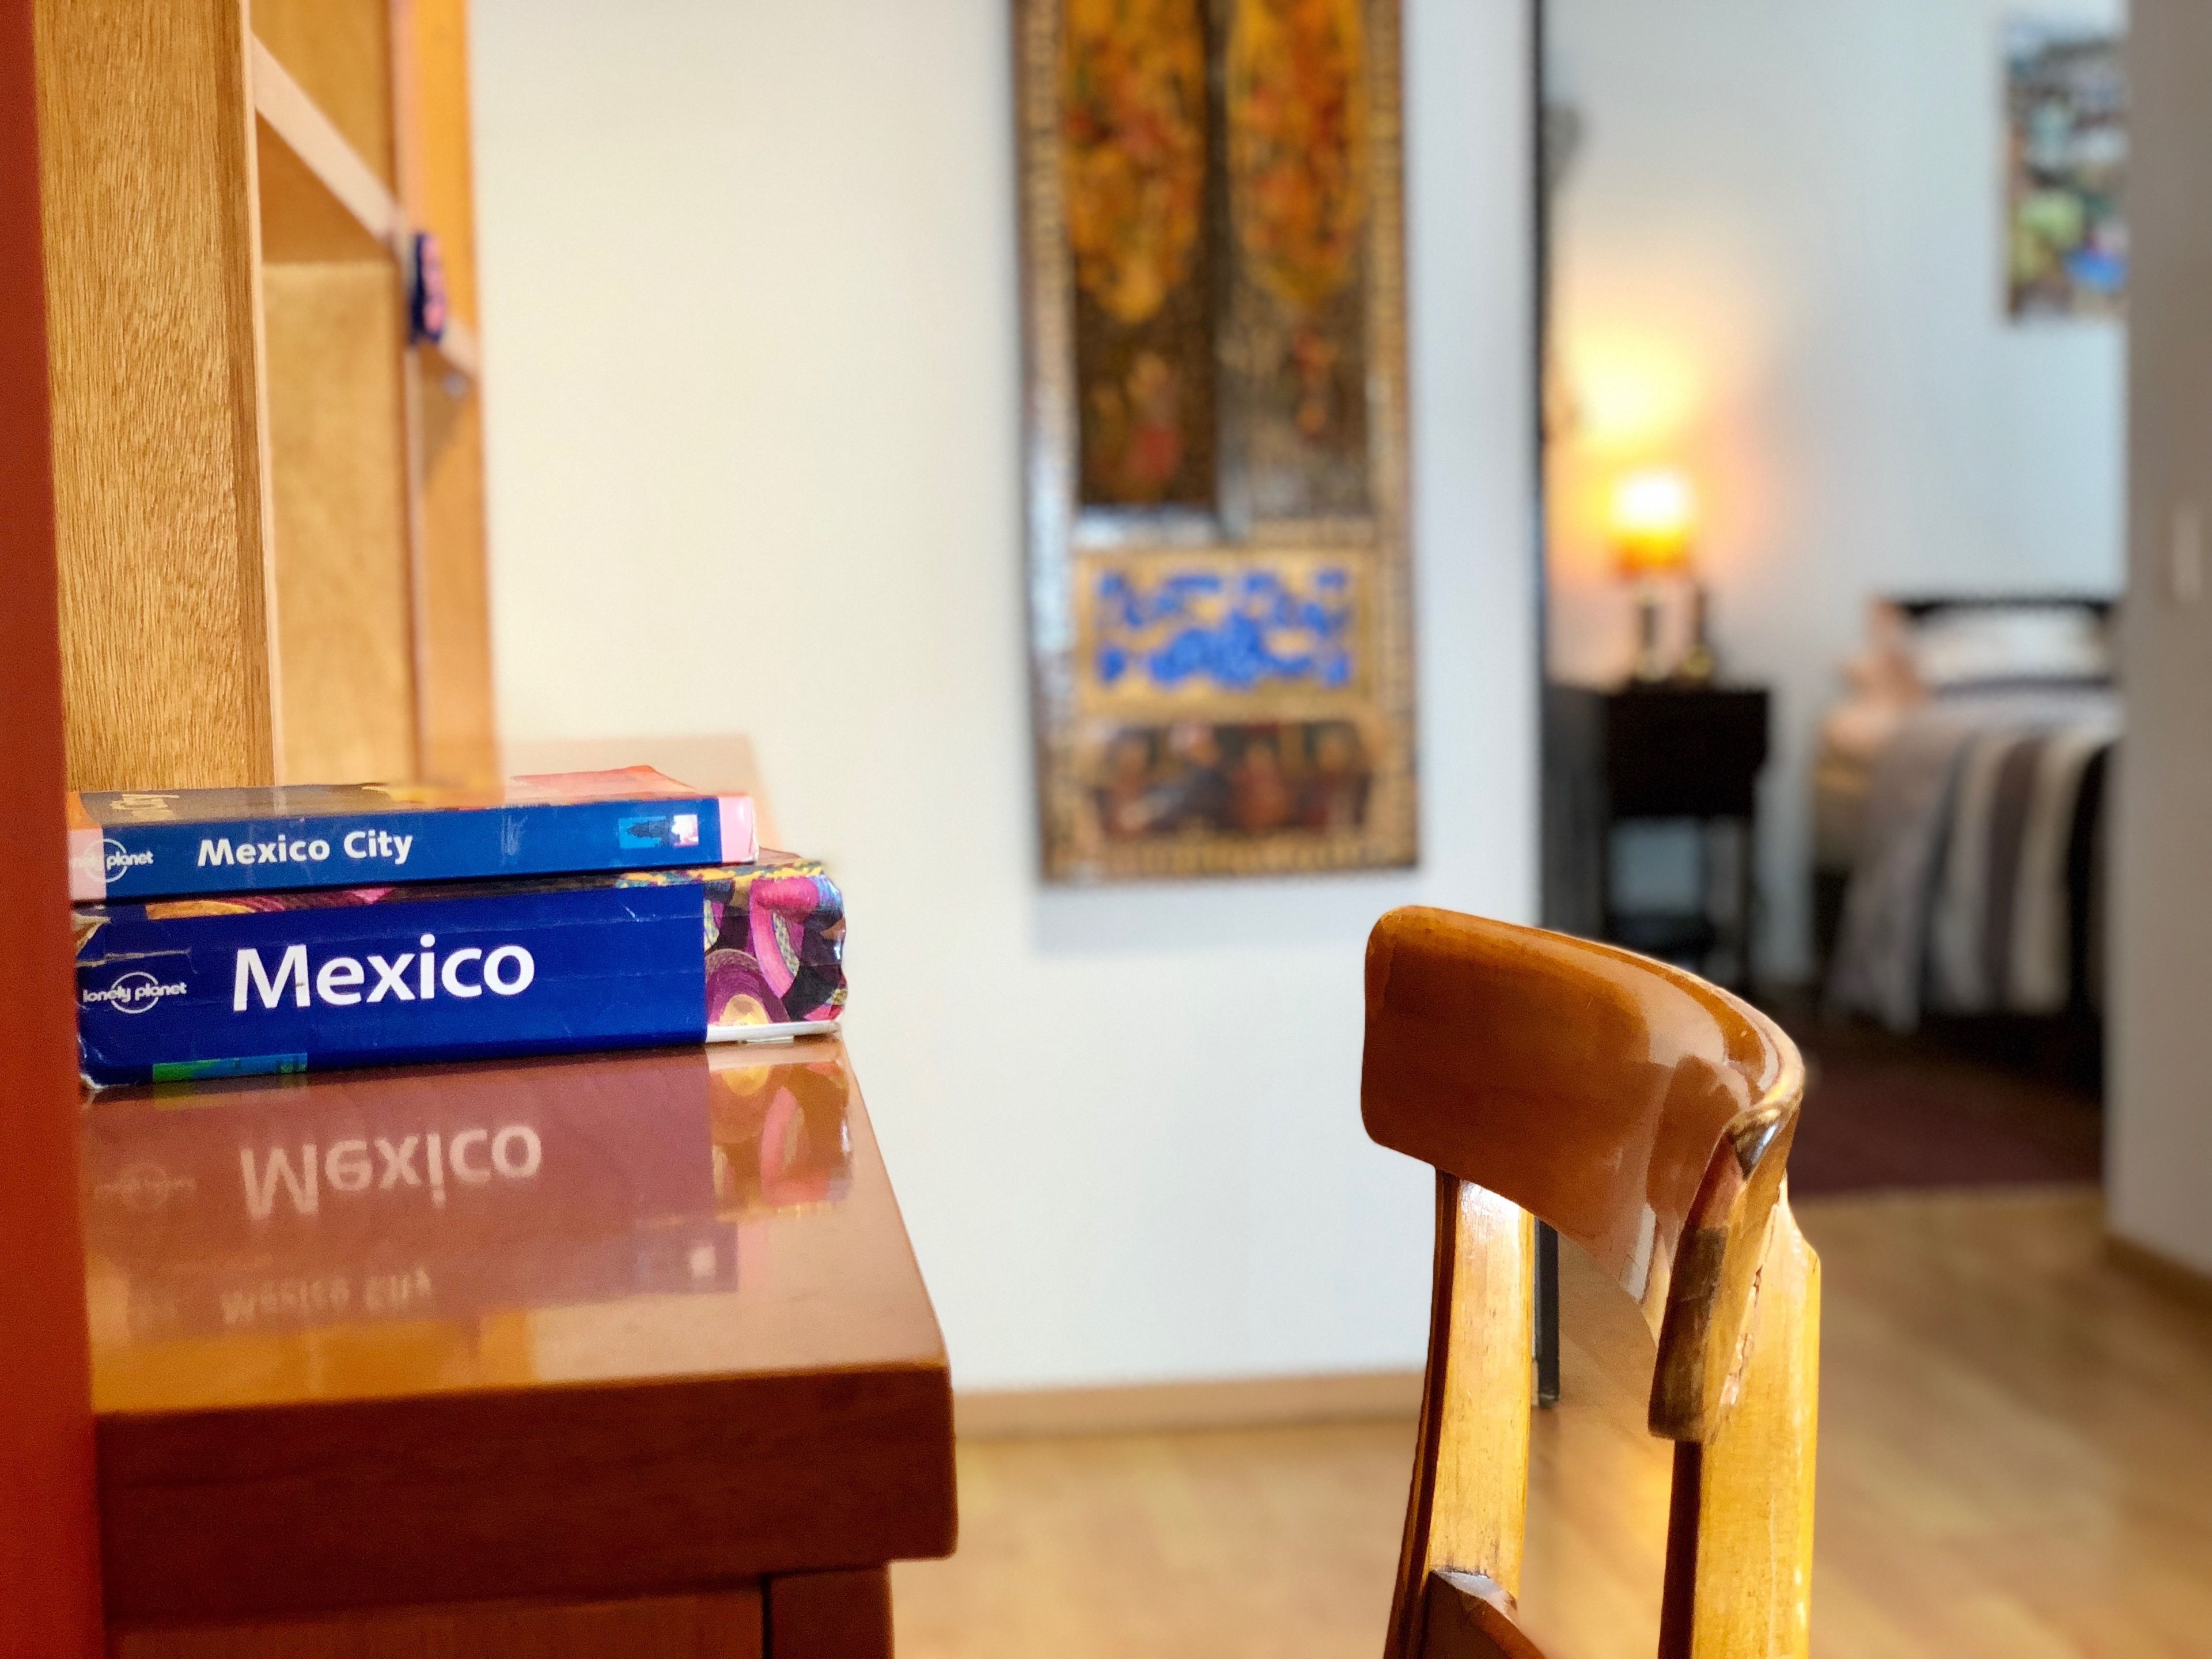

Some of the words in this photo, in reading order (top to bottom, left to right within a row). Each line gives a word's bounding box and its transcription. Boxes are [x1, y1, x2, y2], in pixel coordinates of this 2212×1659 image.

[107, 850, 153, 870] planet
[198, 834, 330, 866] Mexico
[343, 829, 413, 865] City
[233, 933, 535, 1012] Mexico
[82, 985, 131, 1003] lonely
[134, 982, 187, 1001] planet
